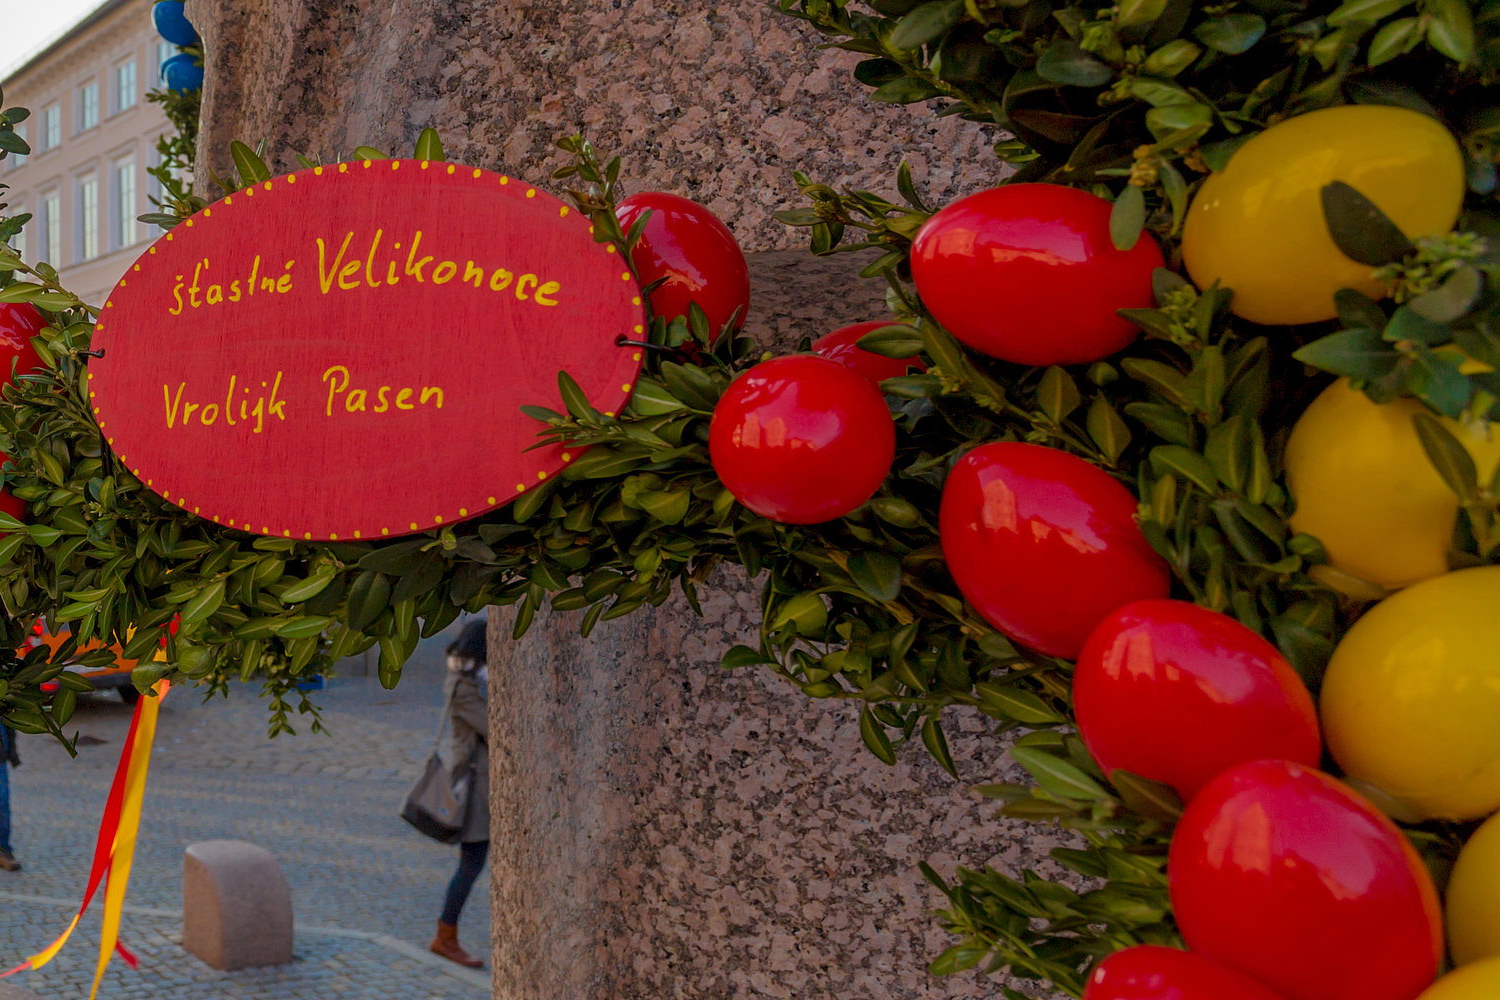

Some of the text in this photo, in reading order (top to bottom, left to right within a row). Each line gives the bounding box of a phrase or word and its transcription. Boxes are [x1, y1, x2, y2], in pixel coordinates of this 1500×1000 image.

[316, 228, 561, 307] Velikonoce
[163, 365, 445, 434] Vrolijk Pasen
